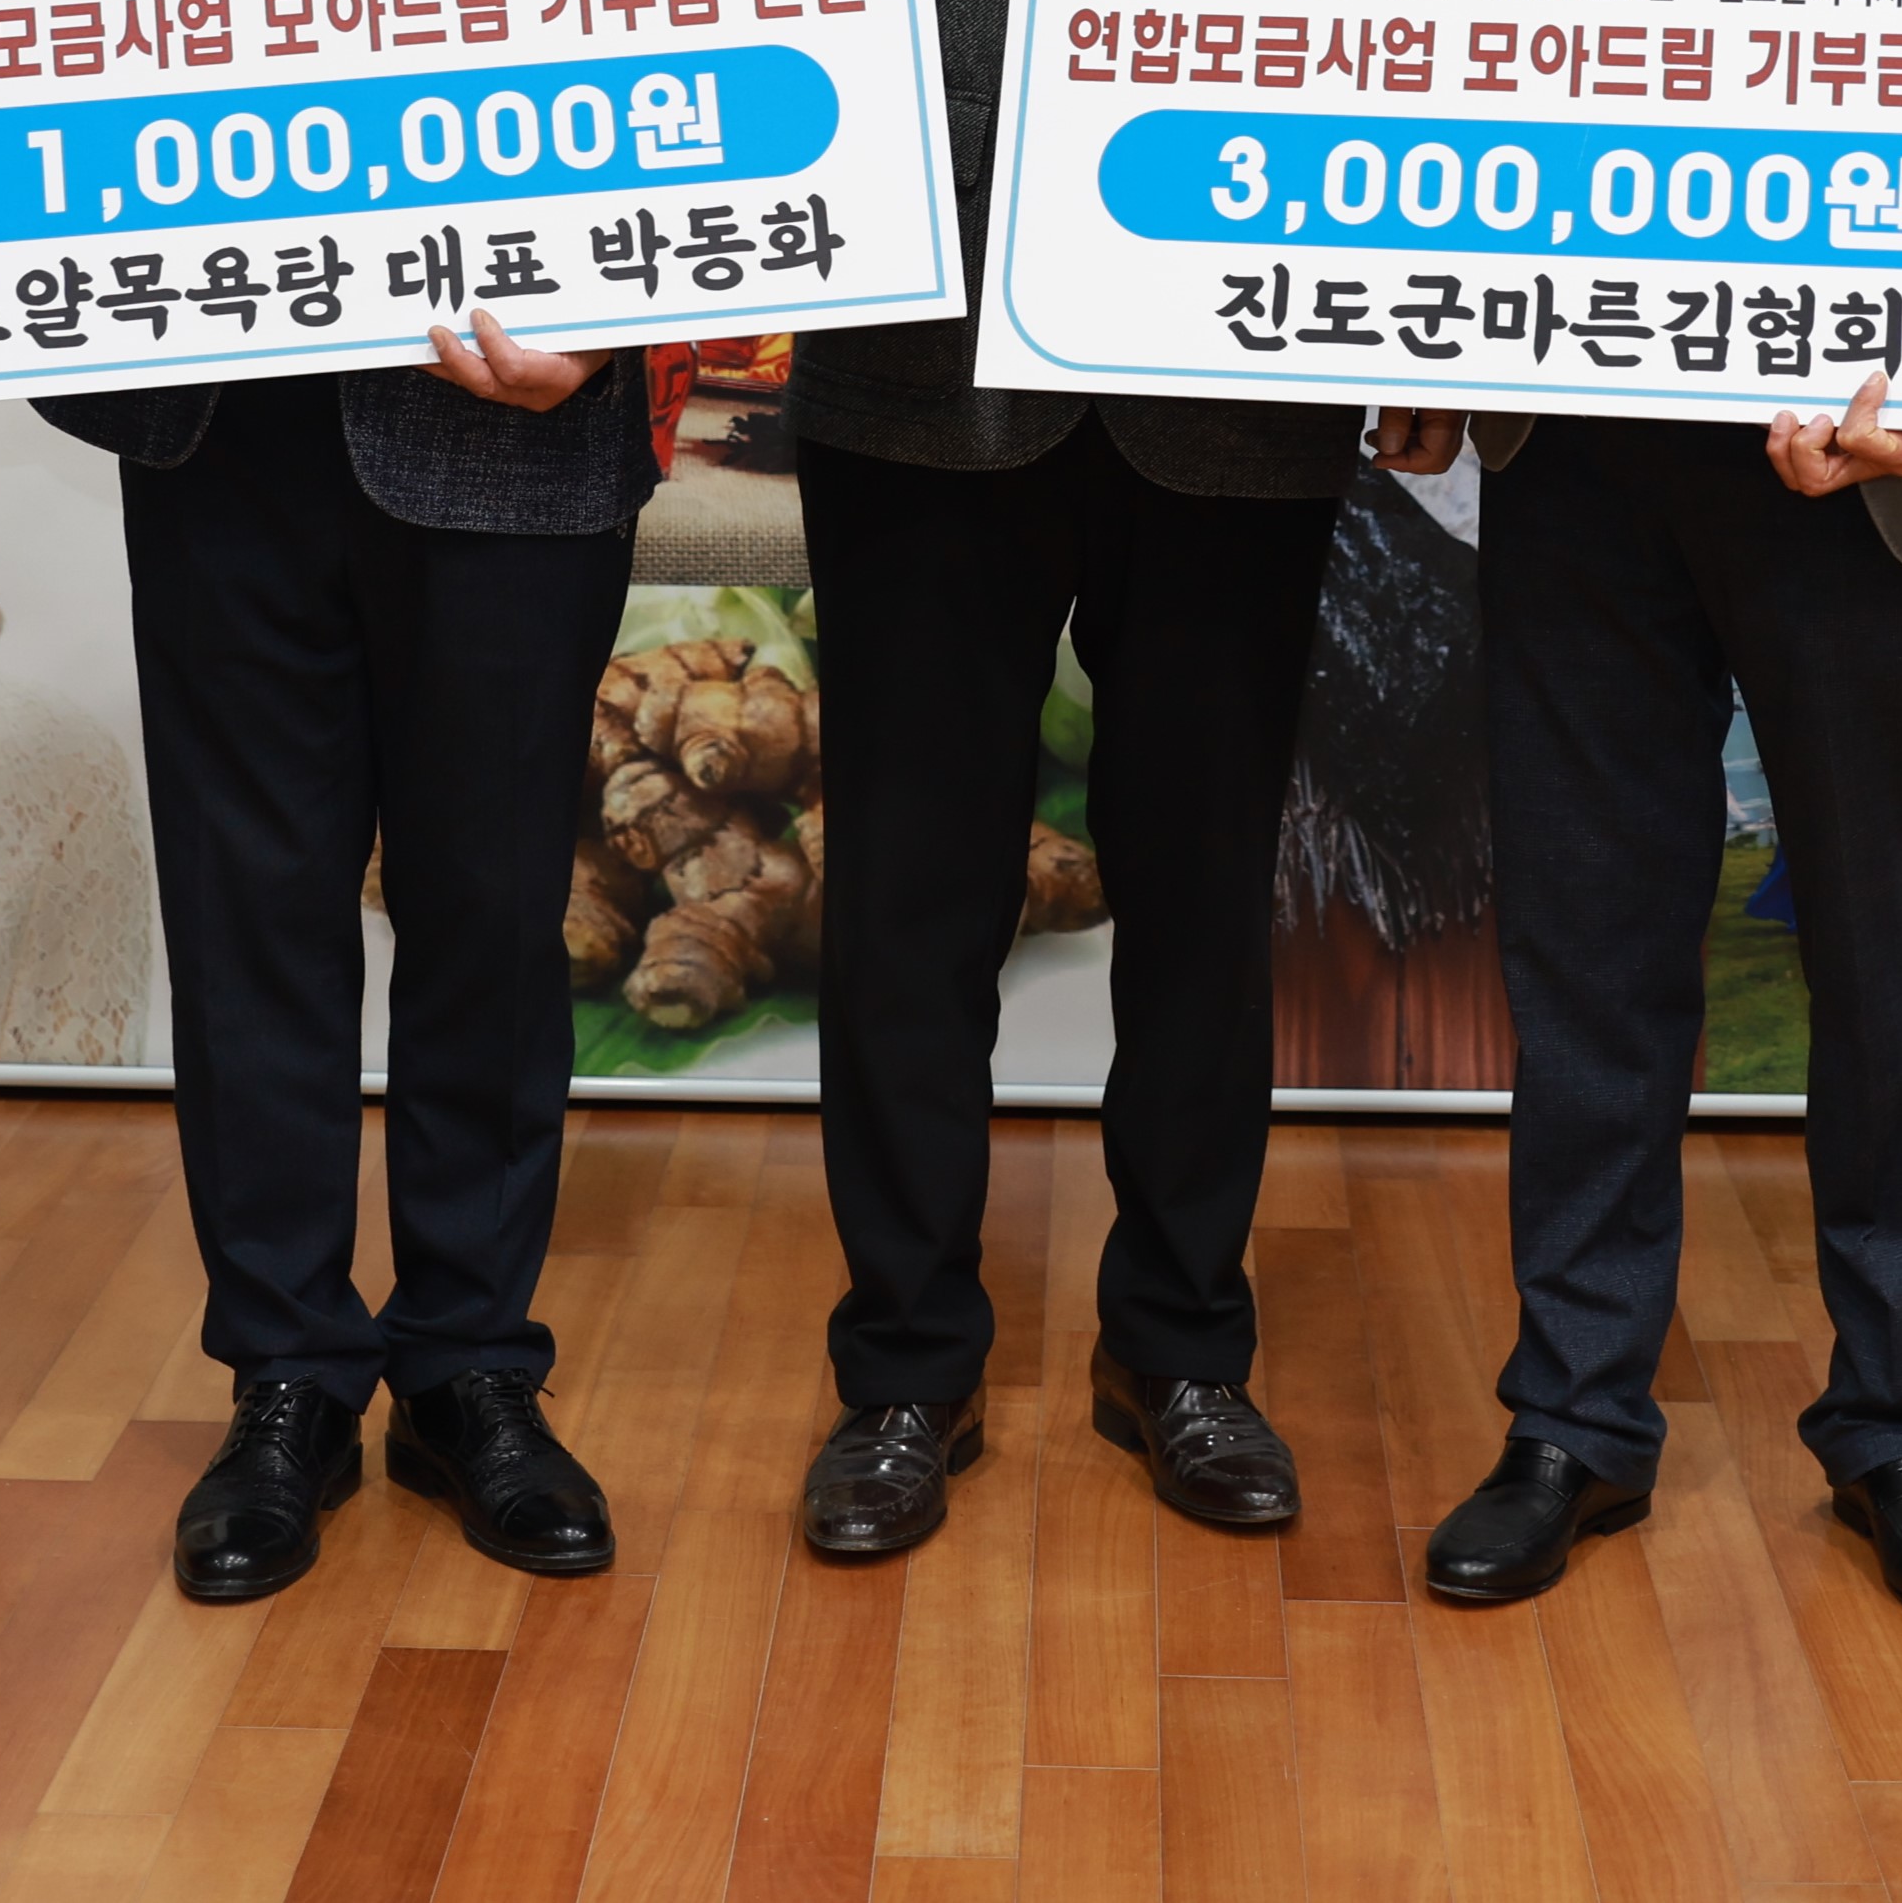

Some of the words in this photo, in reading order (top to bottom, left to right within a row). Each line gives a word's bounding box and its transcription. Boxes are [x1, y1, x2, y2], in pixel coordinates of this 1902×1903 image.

[1069, 9, 1435, 92] 연합모금사업
[1464, 23, 1713, 101] 모아드림
[28, 73, 723, 217] 1,000,000원
[386, 227, 560, 317] 대표
[590, 194, 845, 298] 박동화
[1216, 263, 1902, 380] 진도군마른김협회
